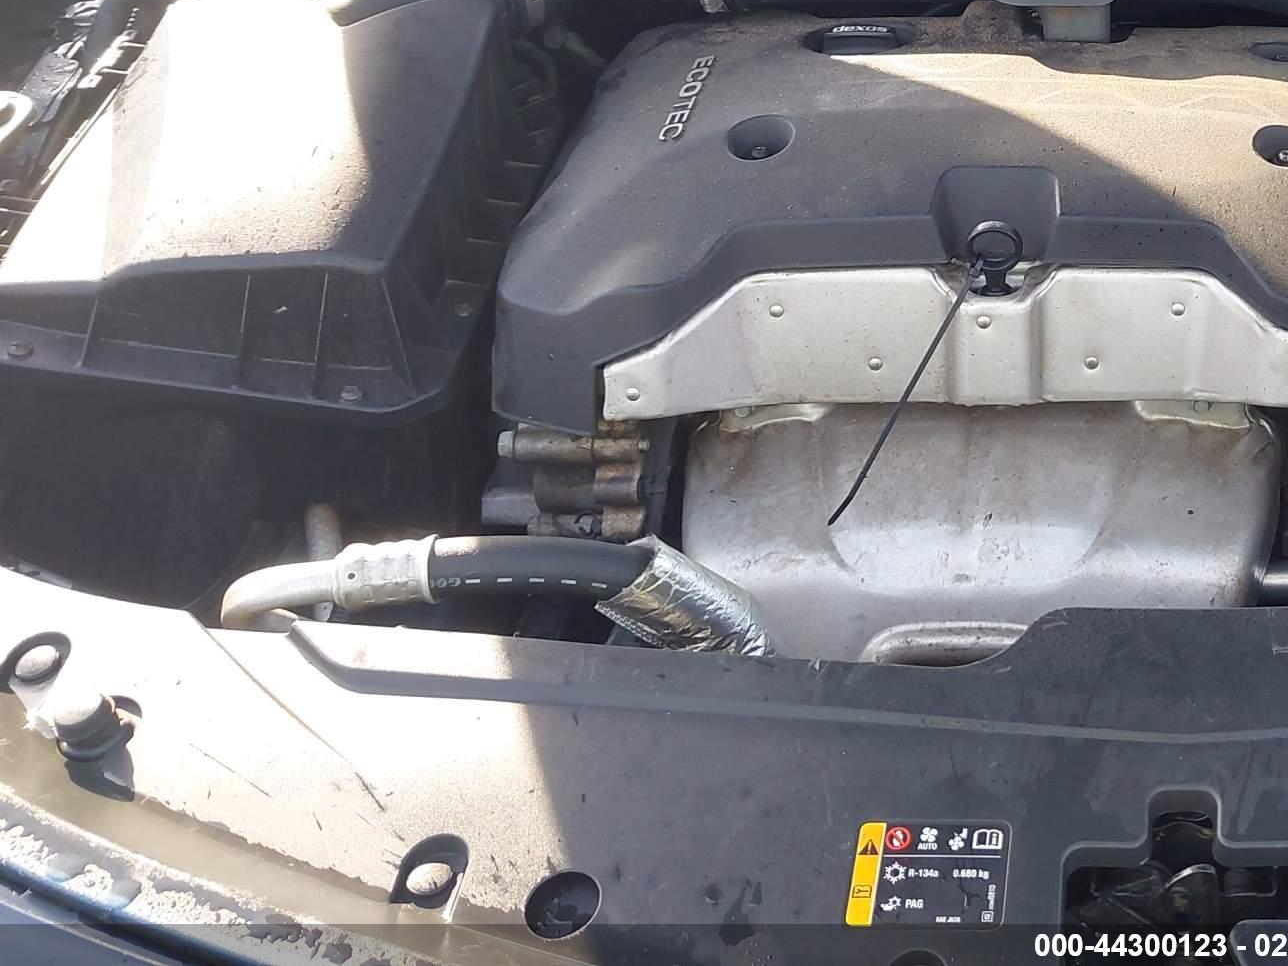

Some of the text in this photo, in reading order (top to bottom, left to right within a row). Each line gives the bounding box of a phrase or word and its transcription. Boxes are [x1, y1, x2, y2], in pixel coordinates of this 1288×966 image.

[832, 25, 888, 33] dexos
[658, 55, 716, 142] ECOTEC
[908, 869, 939, 878] R-134a
[978, 869, 990, 880] kg
[905, 899, 924, 909] PAG
